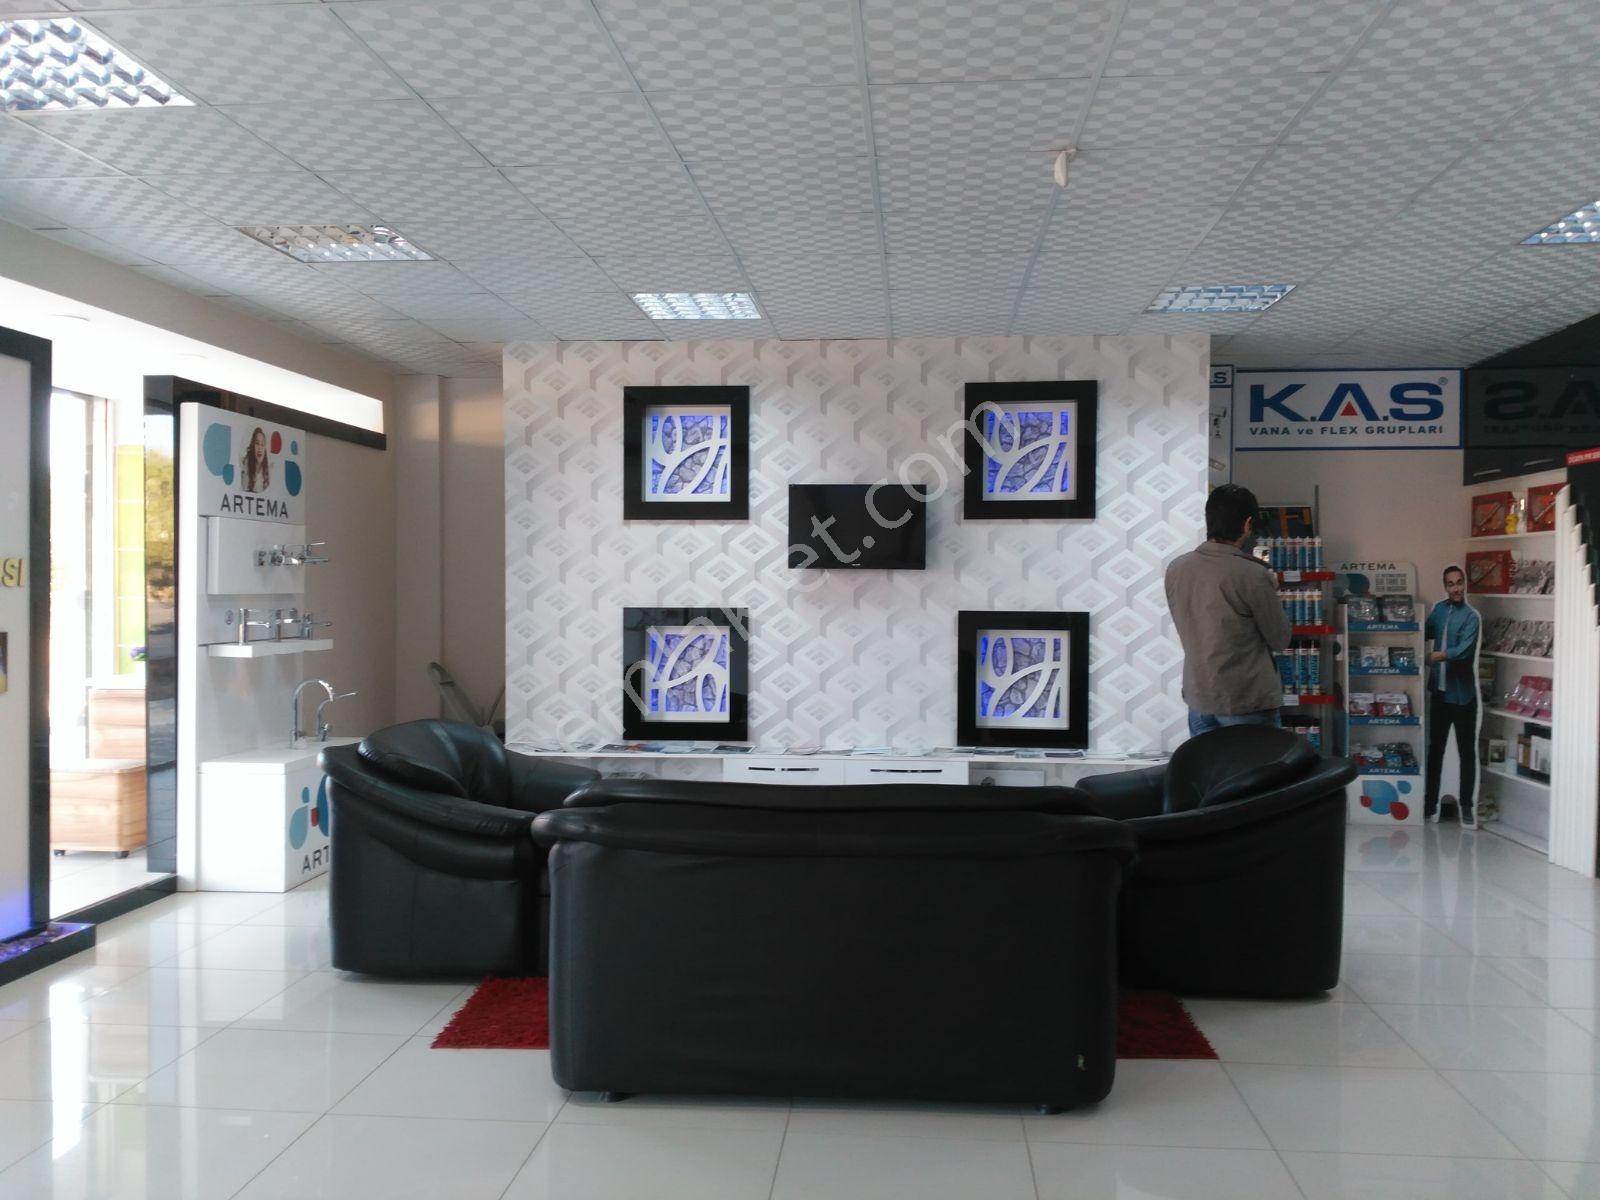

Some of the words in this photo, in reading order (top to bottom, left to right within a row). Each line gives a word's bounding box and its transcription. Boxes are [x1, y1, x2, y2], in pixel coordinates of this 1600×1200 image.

[1250, 382, 1444, 422] K.A.S
[1250, 427, 1291, 436] VANA
[1297, 427, 1314, 435] ve
[1320, 426, 1358, 435] FLEX
[1365, 425, 1443, 434] GRUPLARI
[220, 493, 289, 518] ARTEMA
[1340, 562, 1396, 571] ARTEMA
